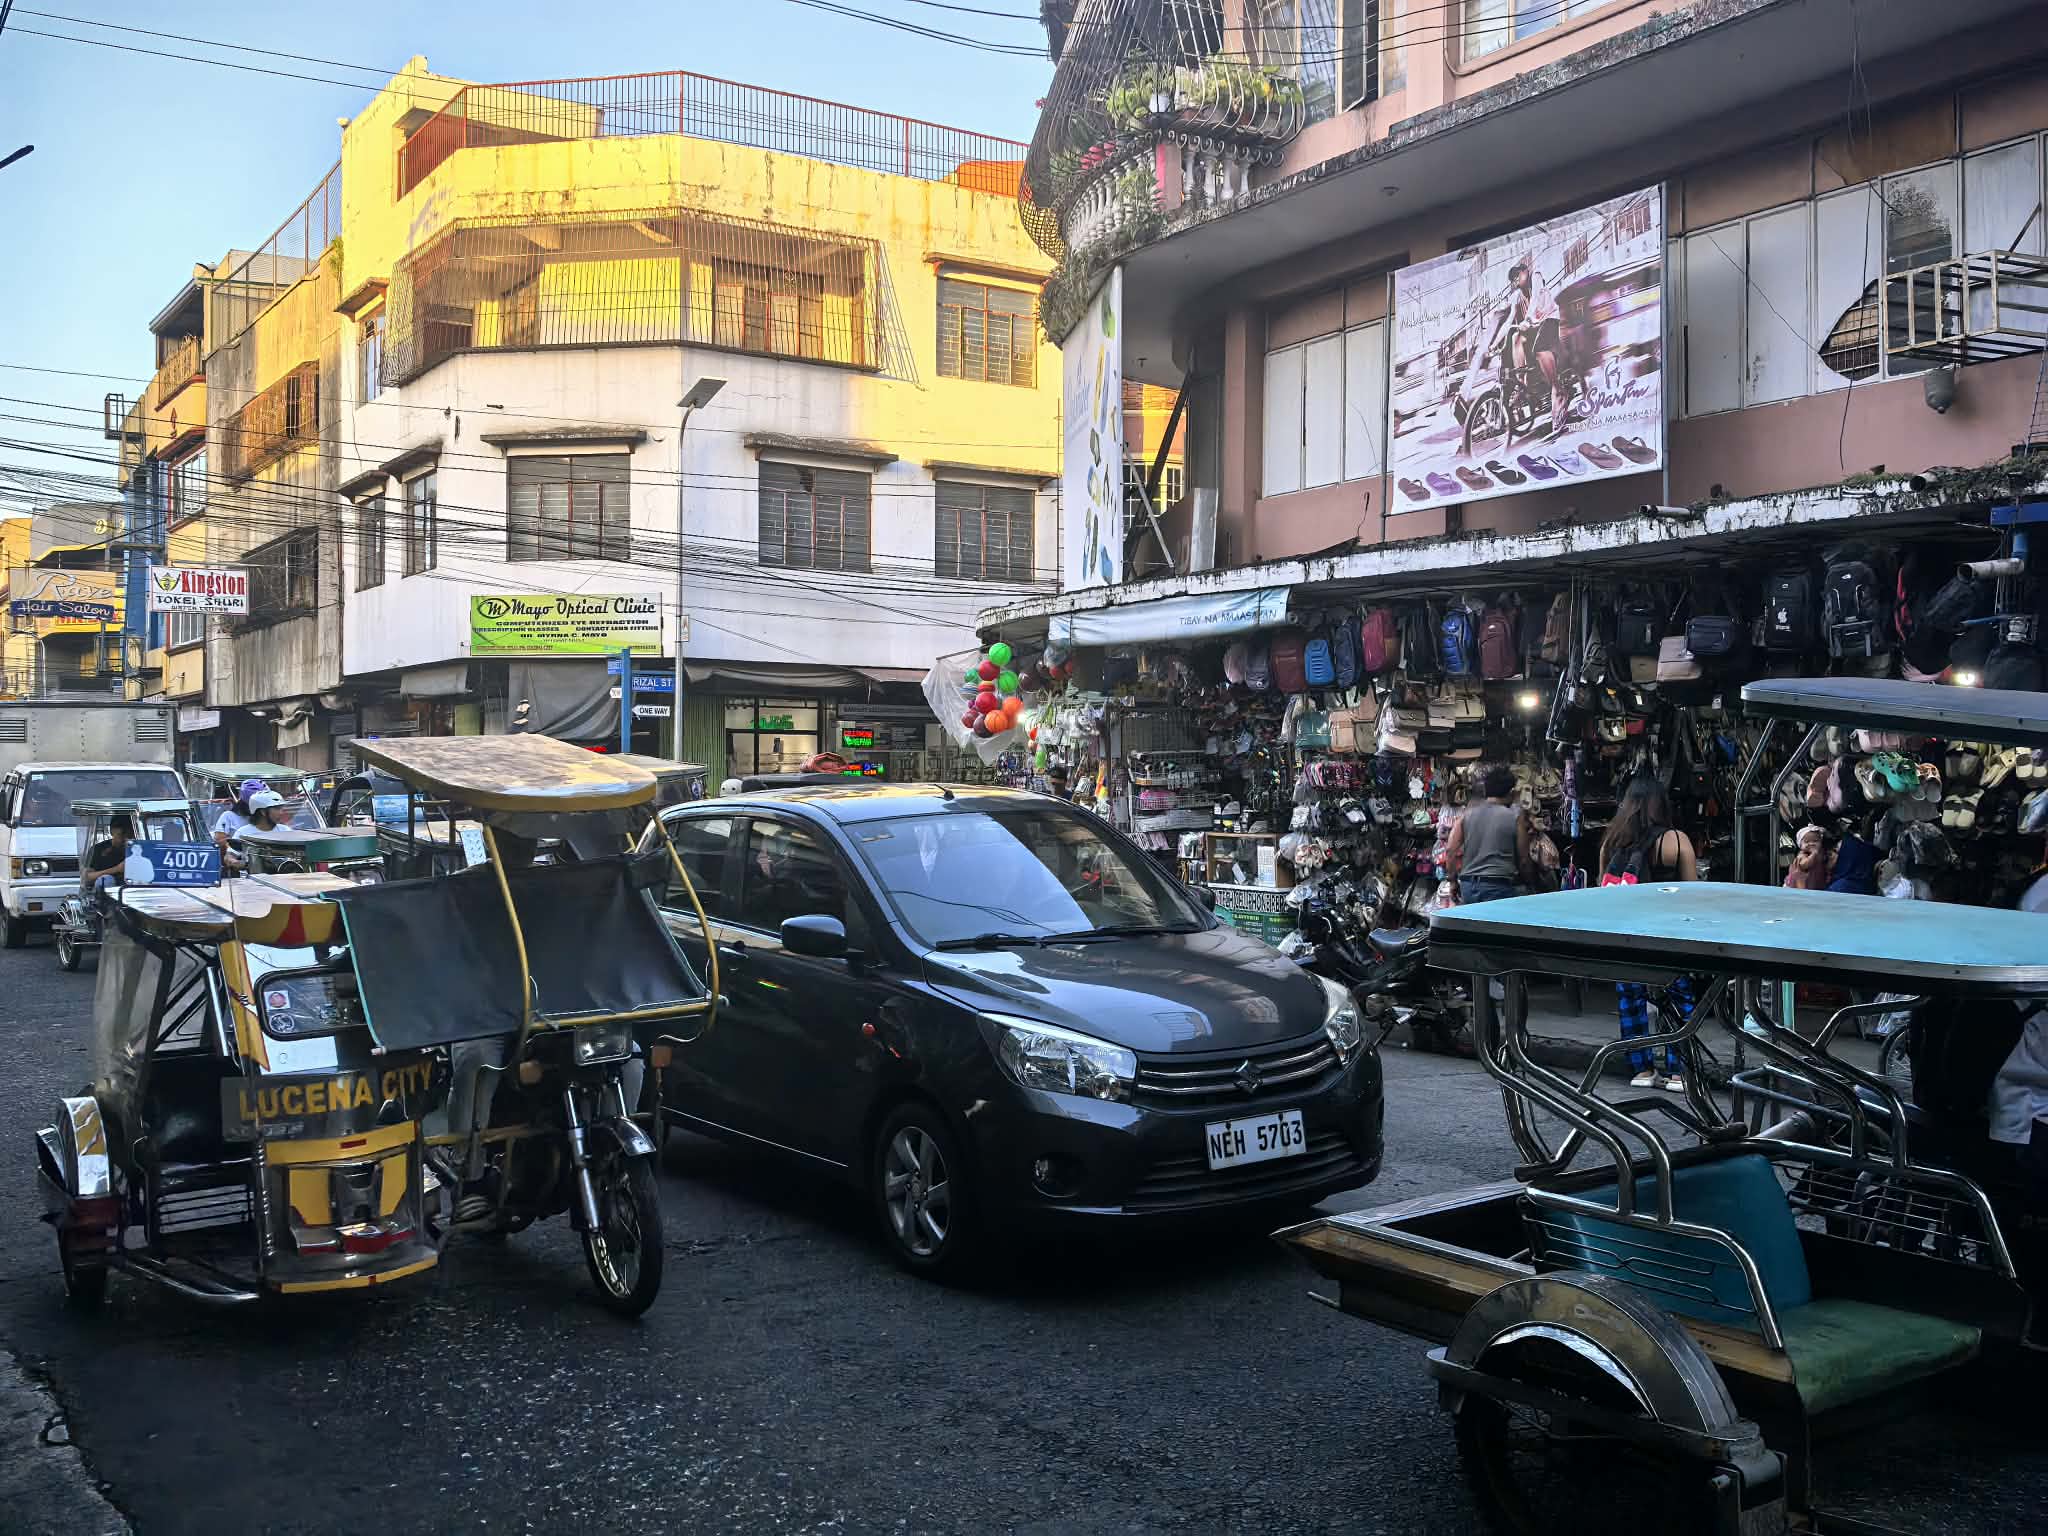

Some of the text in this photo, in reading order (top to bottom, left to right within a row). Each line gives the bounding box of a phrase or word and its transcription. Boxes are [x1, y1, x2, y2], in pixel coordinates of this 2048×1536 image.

[1577, 379, 1650, 416] Spartan
[181, 570, 245, 597] Kingston
[17, 600, 110, 616] Hair Salon
[156, 595, 243, 607] TOKEI SHURI
[511, 598, 554, 620] Mayo
[556, 598, 608, 619] Optical
[614, 597, 656, 614] Clinic
[1204, 615, 1217, 625] NA
[633, 678, 672, 687] RIZAL ST
[654, 707, 668, 715] WAY
[163, 851, 209, 869] 4007
[239, 1061, 435, 1121] LUCENA CITY
[1210, 1120, 1303, 1160] NEH 5703
